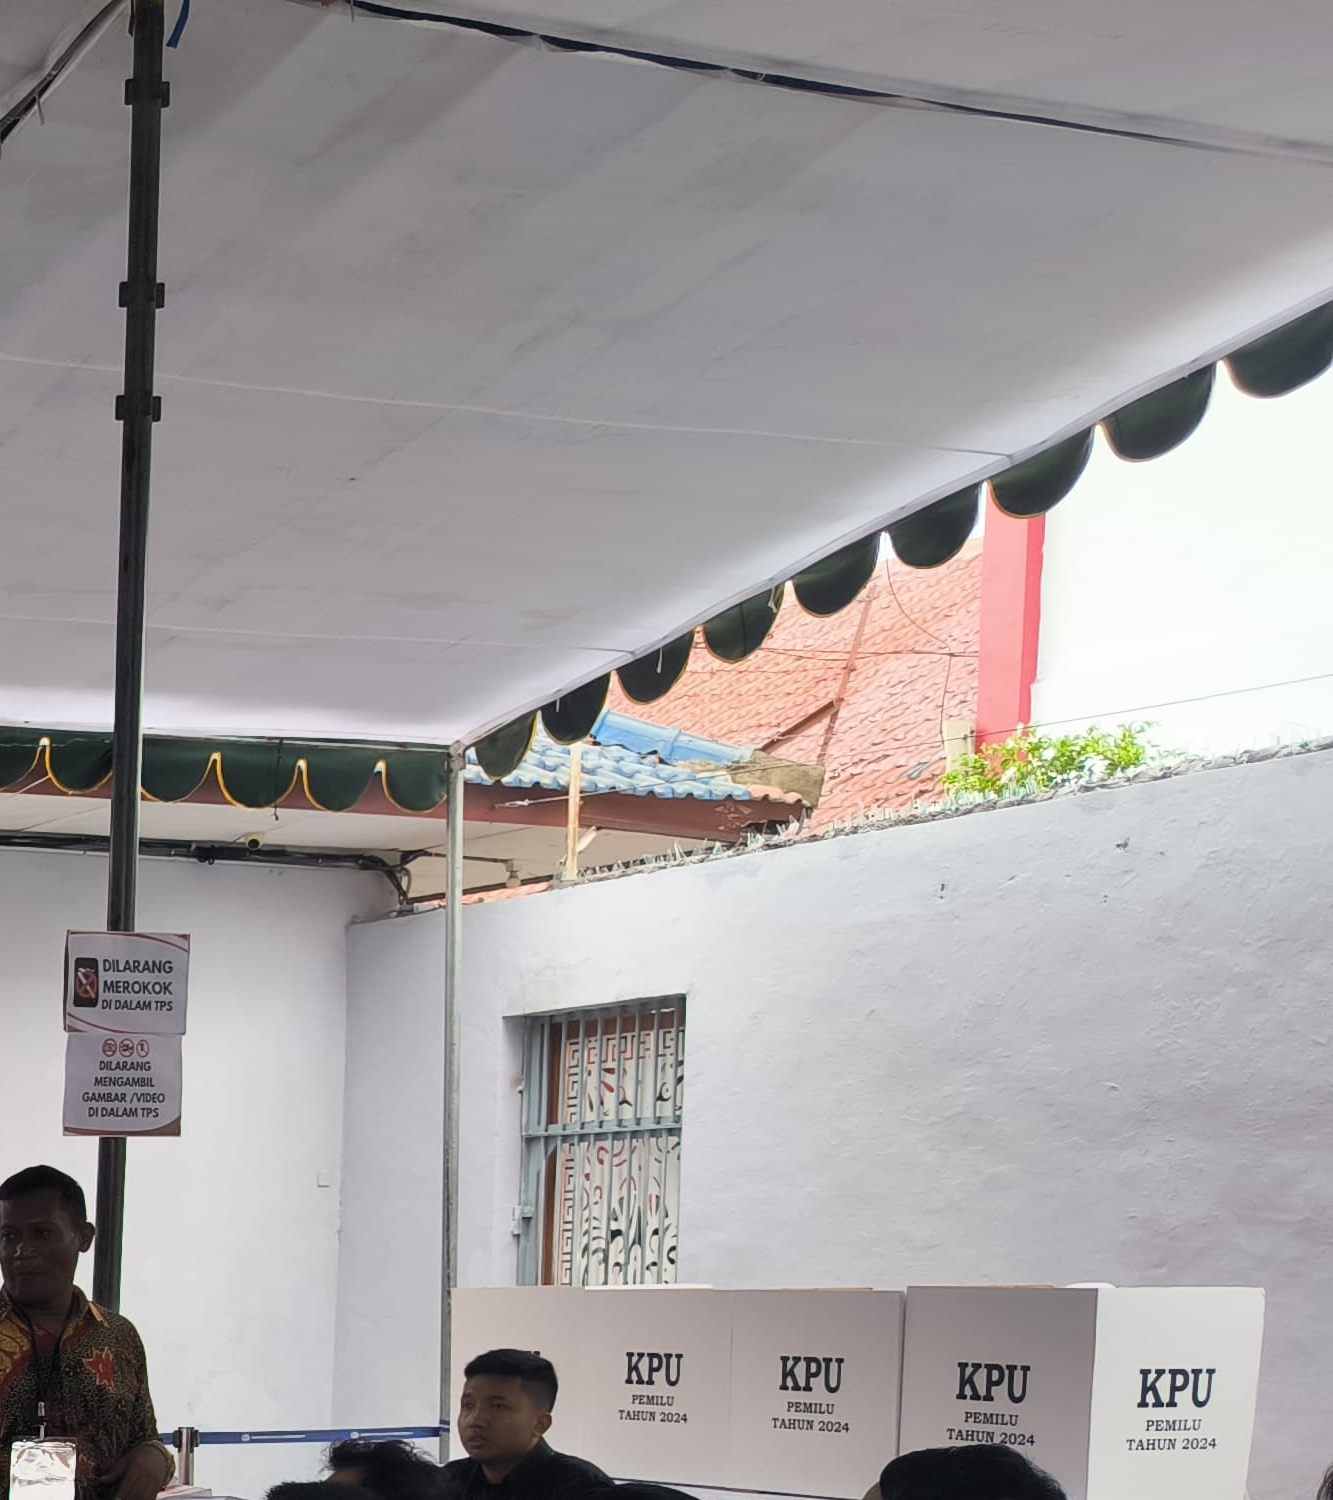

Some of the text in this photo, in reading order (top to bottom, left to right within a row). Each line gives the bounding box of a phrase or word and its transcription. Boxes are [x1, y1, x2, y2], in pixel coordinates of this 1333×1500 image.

[102, 959, 173, 974] DILARANG
[103, 980, 173, 995] MEROKOK
[101, 999, 173, 1011] DI DALAM TPS
[99, 1060, 151, 1072] DILARANG
[93, 1076, 155, 1088] MENGAMBIL
[81, 1091, 166, 1104] GAMBAR /VIDEO
[88, 1107, 159, 1118] DI DALAM TPS
[624, 1351, 684, 1387] KPU
[779, 1355, 845, 1394] KPU
[955, 1361, 1031, 1404] KPU
[1136, 1368, 1216, 1408] KPU
[631, 1394, 674, 1407] PEMILU
[786, 1401, 835, 1415] PEMILU
[618, 1409, 689, 1424] TAHUN 2024
[964, 1411, 1019, 1427] PEMILU
[772, 1417, 850, 1434] TAHUN 2024
[1145, 1419, 1202, 1432] PEMILU
[946, 1428, 1036, 1447] TAHUN 2024
[1126, 1437, 1217, 1451] TAHUN 2024
